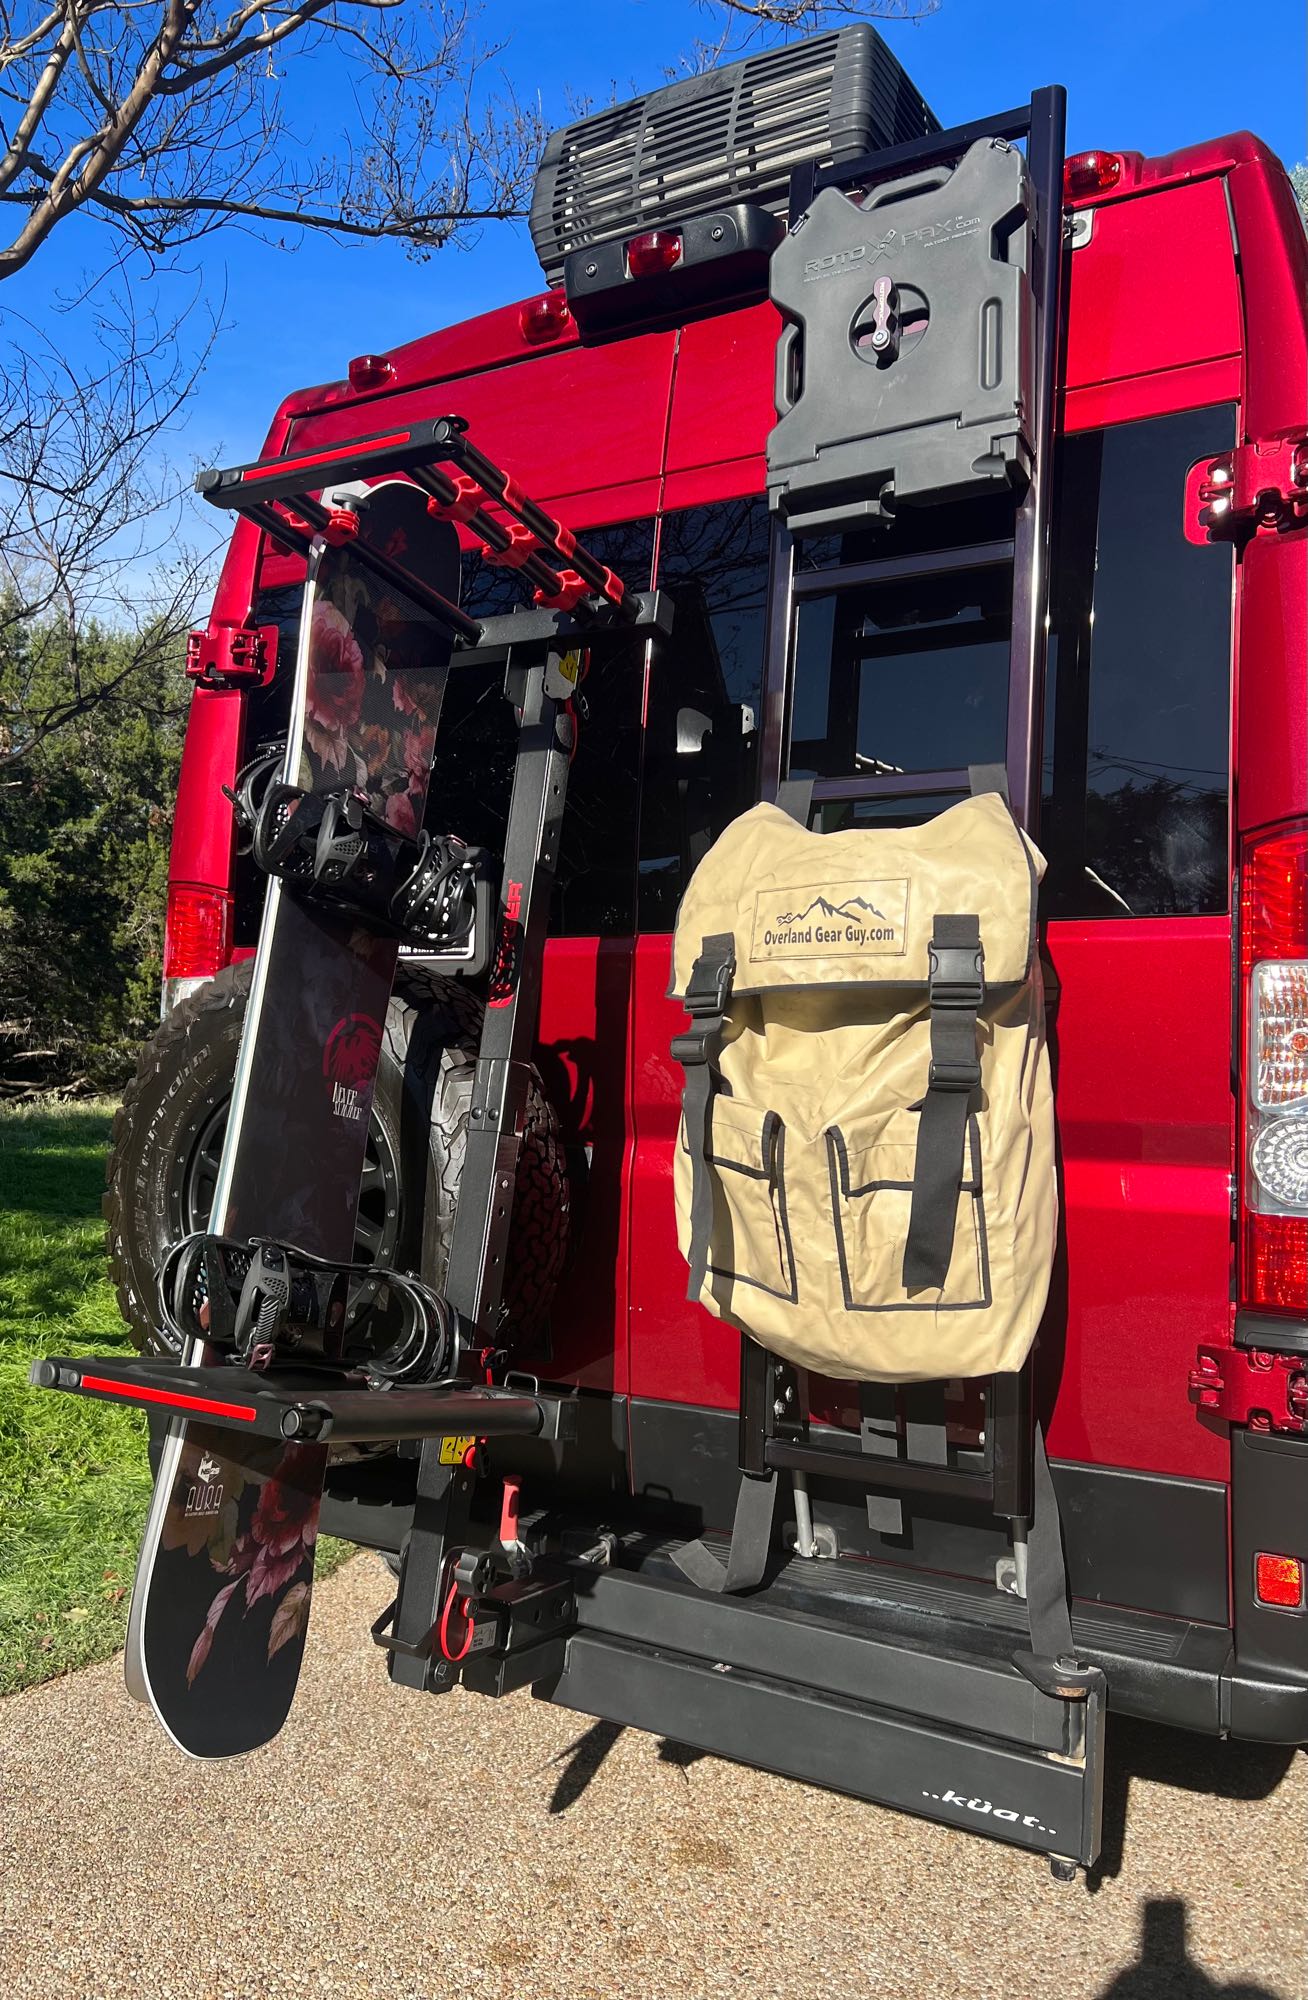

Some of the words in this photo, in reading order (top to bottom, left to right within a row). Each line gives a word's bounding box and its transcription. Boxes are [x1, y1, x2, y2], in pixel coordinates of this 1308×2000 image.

[803, 245, 866, 274] ROTO
[764, 926, 812, 946] Overland
[815, 926, 842, 943] Gear
[845, 925, 895, 946] Guy.com
[185, 1484, 224, 1512] AURA
